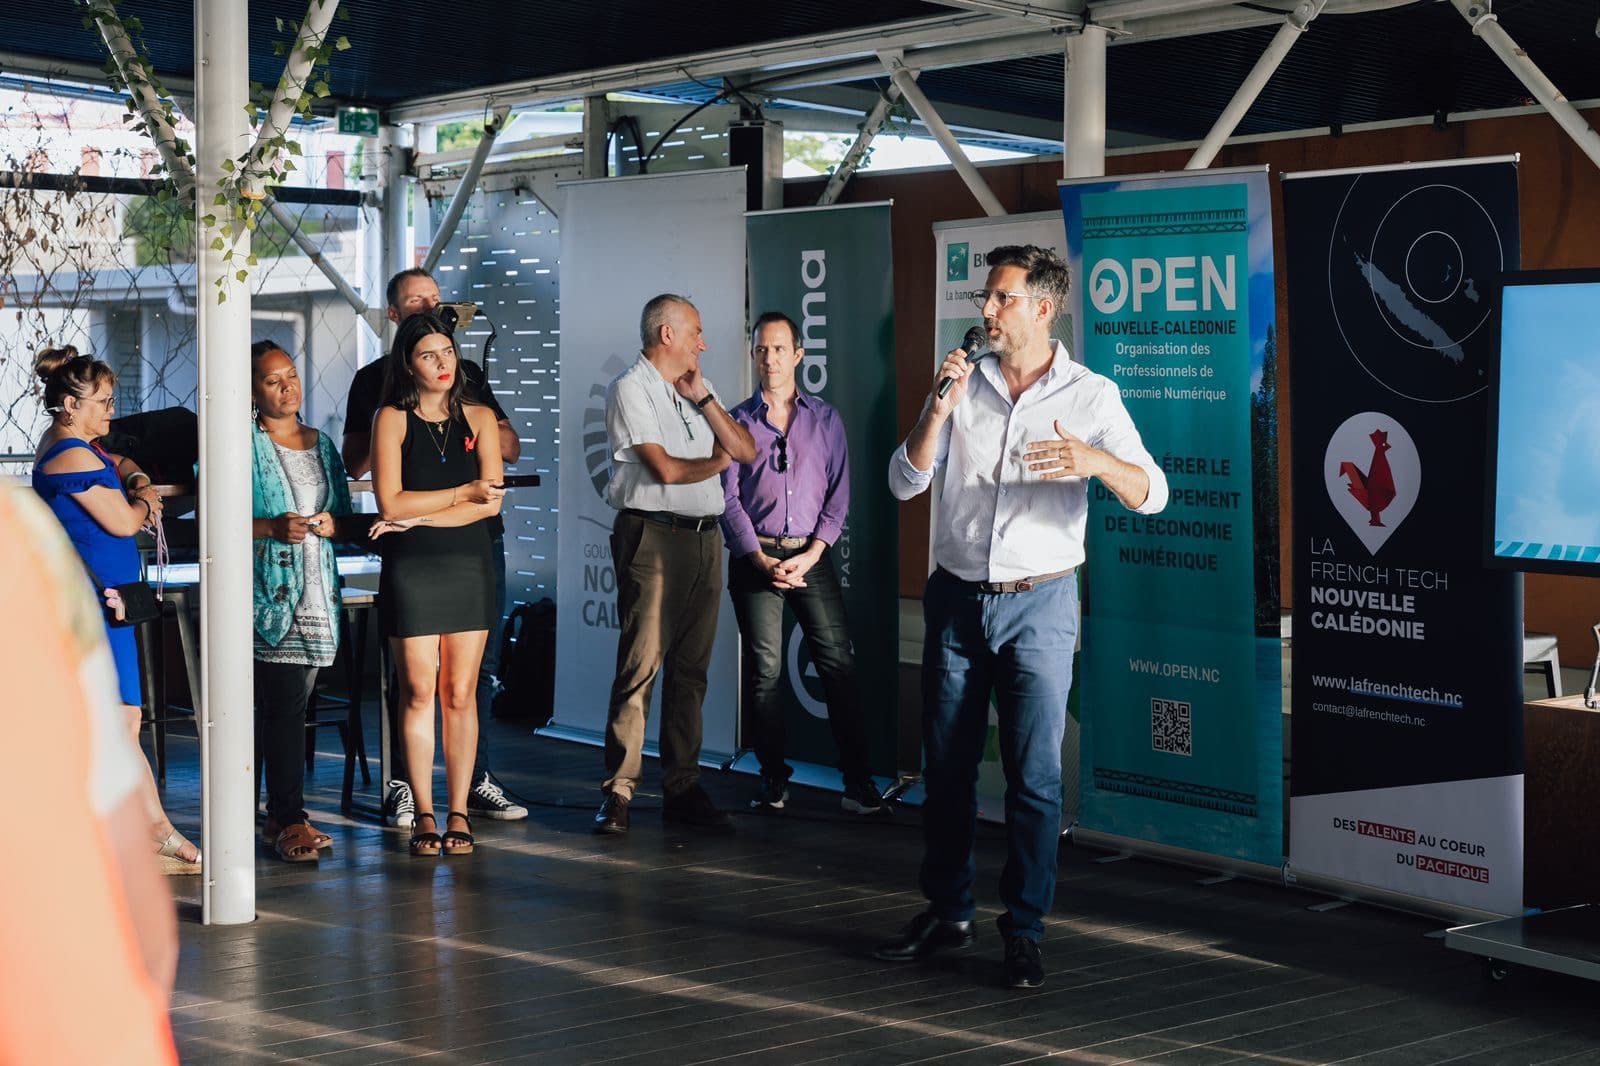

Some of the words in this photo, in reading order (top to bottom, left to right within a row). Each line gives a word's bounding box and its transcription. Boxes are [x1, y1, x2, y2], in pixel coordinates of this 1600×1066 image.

[945, 290, 953, 301] La
[1089, 255, 1236, 314] OPEN
[801, 249, 828, 402] ama
[1094, 319, 1236, 336] NOUVELLE-CALEDONIE
[1115, 342, 1188, 358] Organisation
[1190, 342, 1211, 356] des
[1113, 364, 1197, 377] Professionnels
[1200, 365, 1214, 378] de
[1119, 386, 1161, 399] onomie
[1164, 387, 1226, 402] Numérique
[1161, 452, 1207, 476] ÉRER
[1211, 459, 1232, 477] LE
[1104, 515, 1128, 533] DE
[1119, 545, 1218, 571] NUMÉRIQUE
[1310, 537, 1336, 556] LA
[583, 564, 617, 594] NO
[1310, 561, 1389, 585] FRENCH
[1394, 568, 1449, 591] TECH
[1310, 586, 1416, 614] NOUVELLE
[582, 599, 622, 630] CAL
[1310, 610, 1426, 641] CALÉDONIE
[1129, 658, 1220, 683] WWW.OPEN.NC
[1312, 675, 1463, 706] www.lafrenchtech.nc
[1312, 701, 1427, 728] contact@lafrenchtech.nc
[1333, 817, 1357, 833] DES
[1359, 822, 1415, 843] TALENTS
[1417, 834, 1437, 849] AU
[1439, 838, 1486, 858] COEUR
[1396, 852, 1415, 867] DU
[1418, 856, 1488, 882] PACIFIQUE
